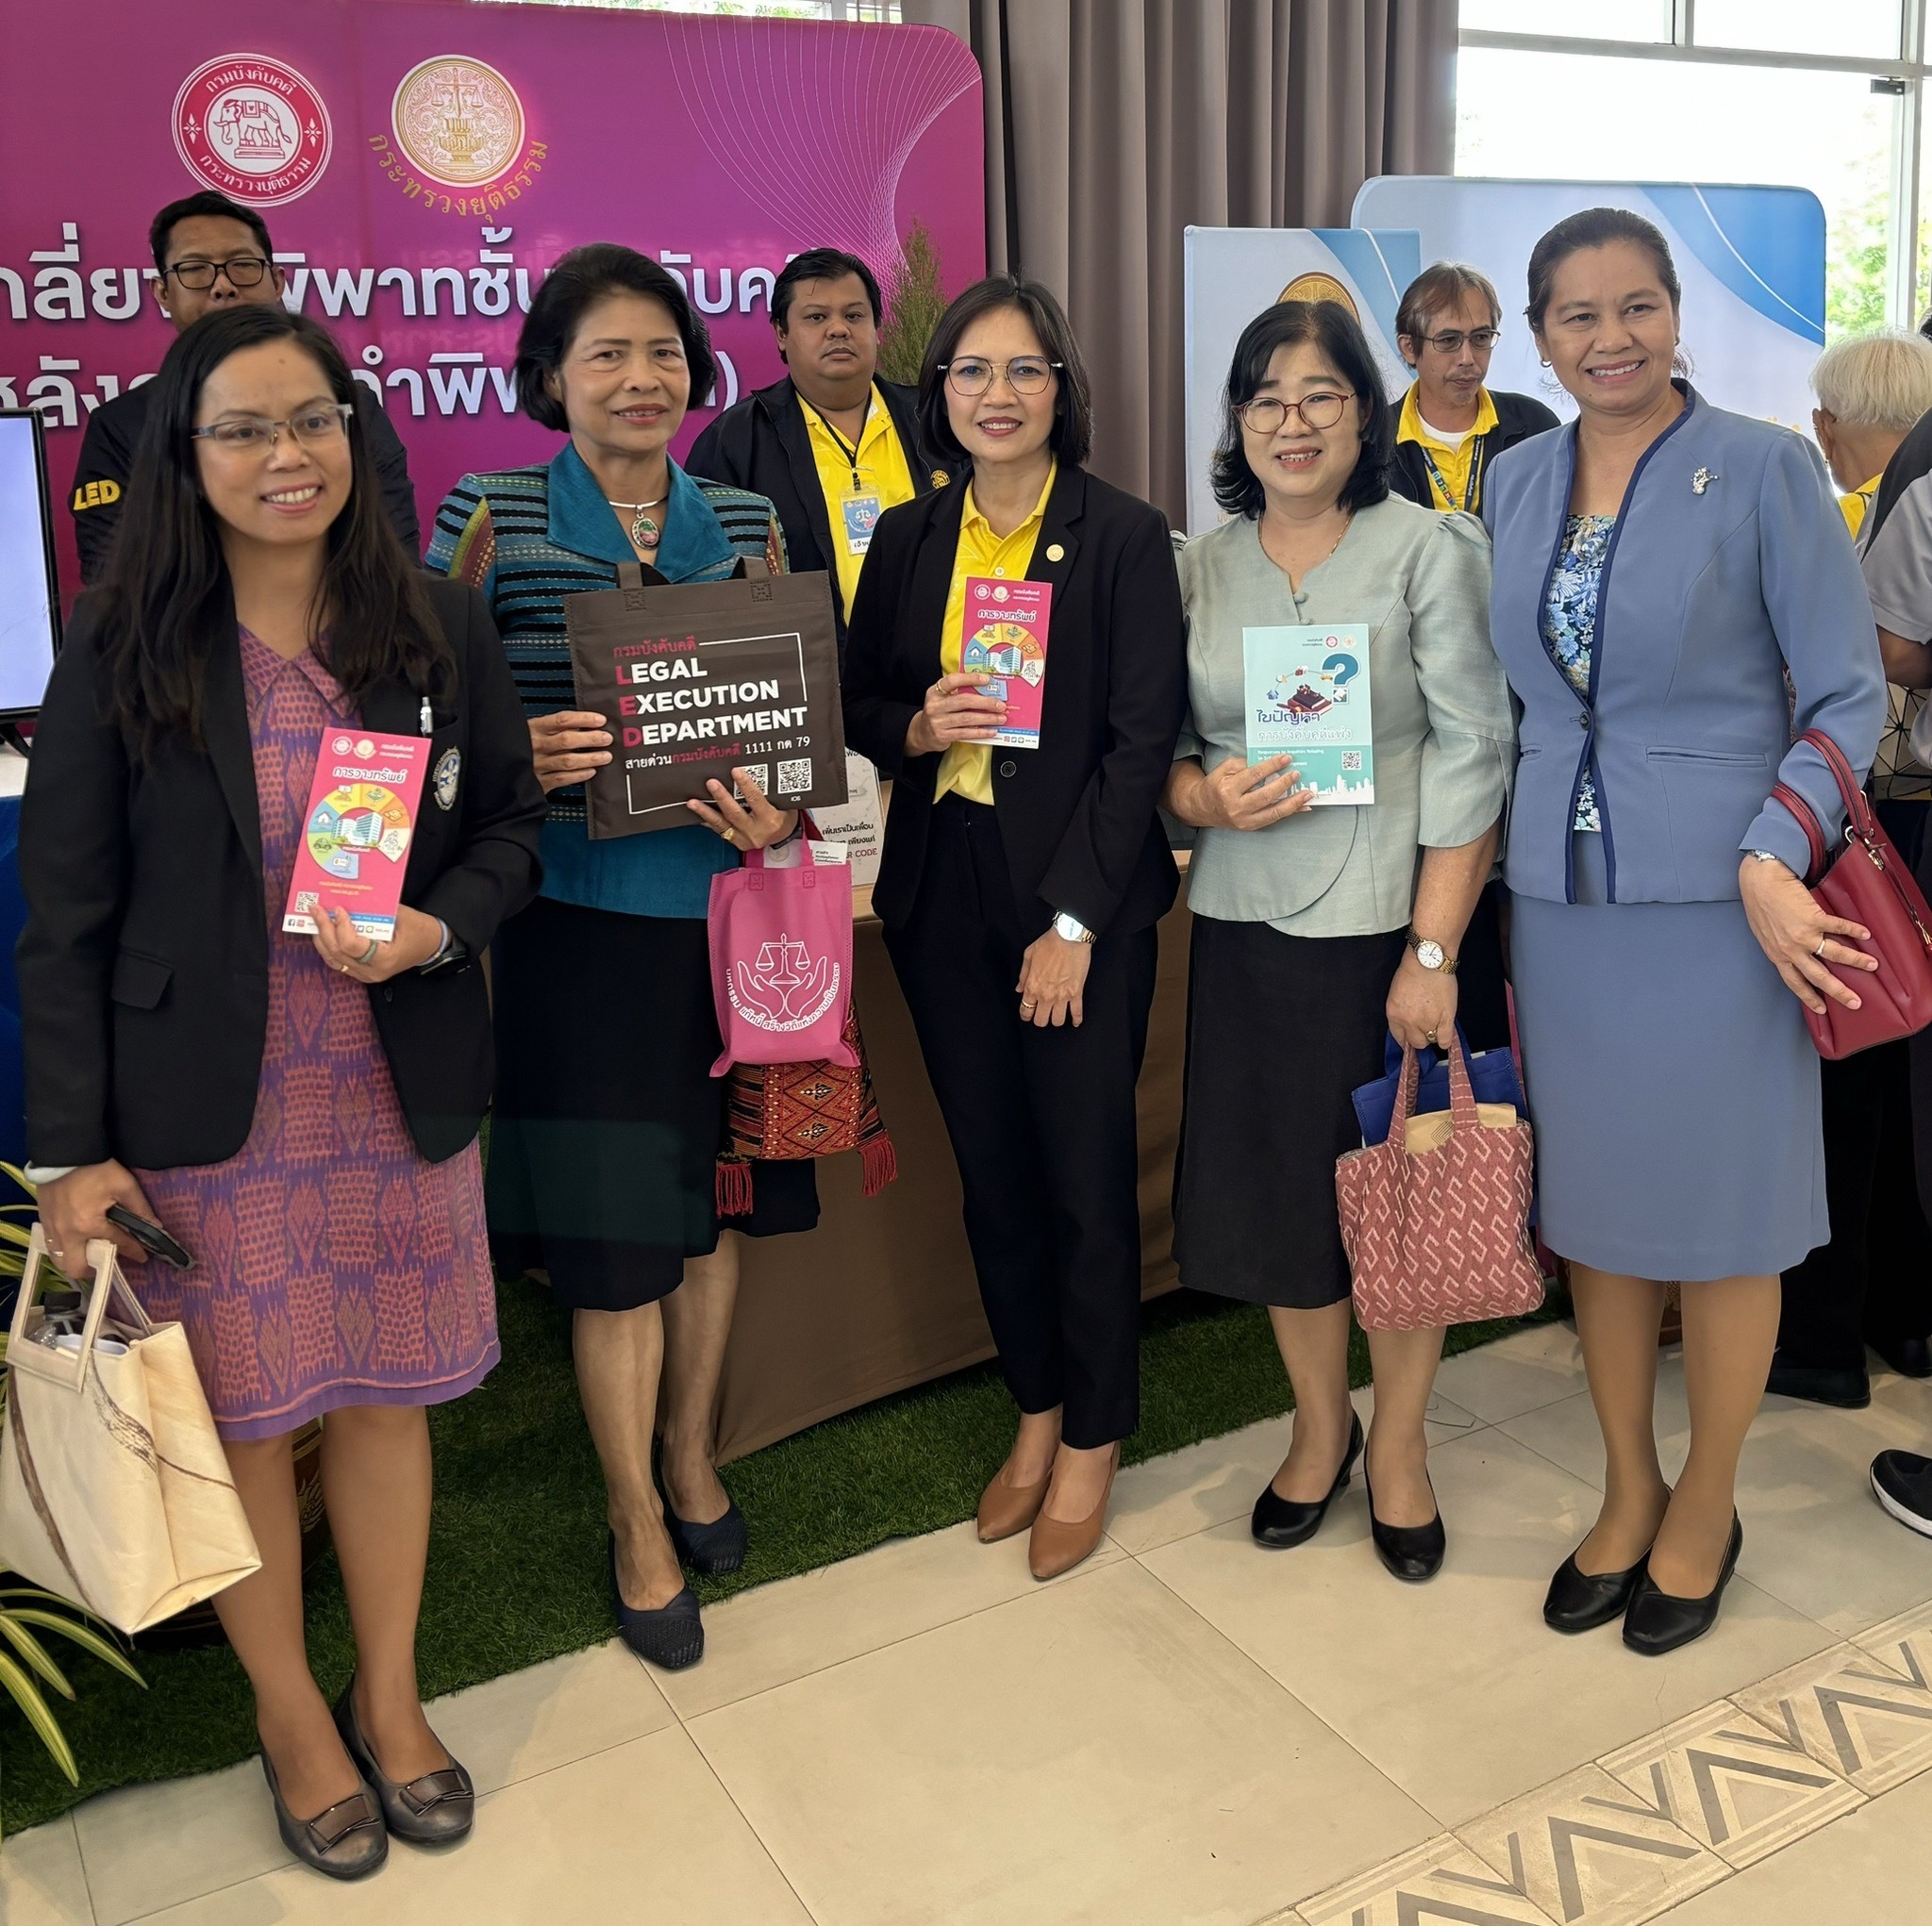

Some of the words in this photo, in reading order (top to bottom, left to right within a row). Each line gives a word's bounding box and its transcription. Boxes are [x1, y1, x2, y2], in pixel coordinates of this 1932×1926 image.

[205, 65, 297, 95] กรมบังคับคดี
[199, 155, 312, 193] กระทรวงยุติธรรม
[369, 134, 550, 224] กระทรวงยุติธรรม
[73, 479, 120, 511] LED
[977, 608, 1037, 623] การวางทรัพย์
[613, 636, 696, 657] กรมบังคับคดี
[615, 657, 708, 686] LEGAL
[619, 679, 779, 717] EXECUTION
[623, 706, 808, 748] DEPARTMENT
[1257, 709, 1321, 725] ไขปัญหา
[745, 741, 773, 755] 1111
[777, 739, 792, 751] กด
[796, 736, 811, 748] 79
[332, 766, 408, 784] การวางทรัพย์
[855, 848, 877, 857] CODE
